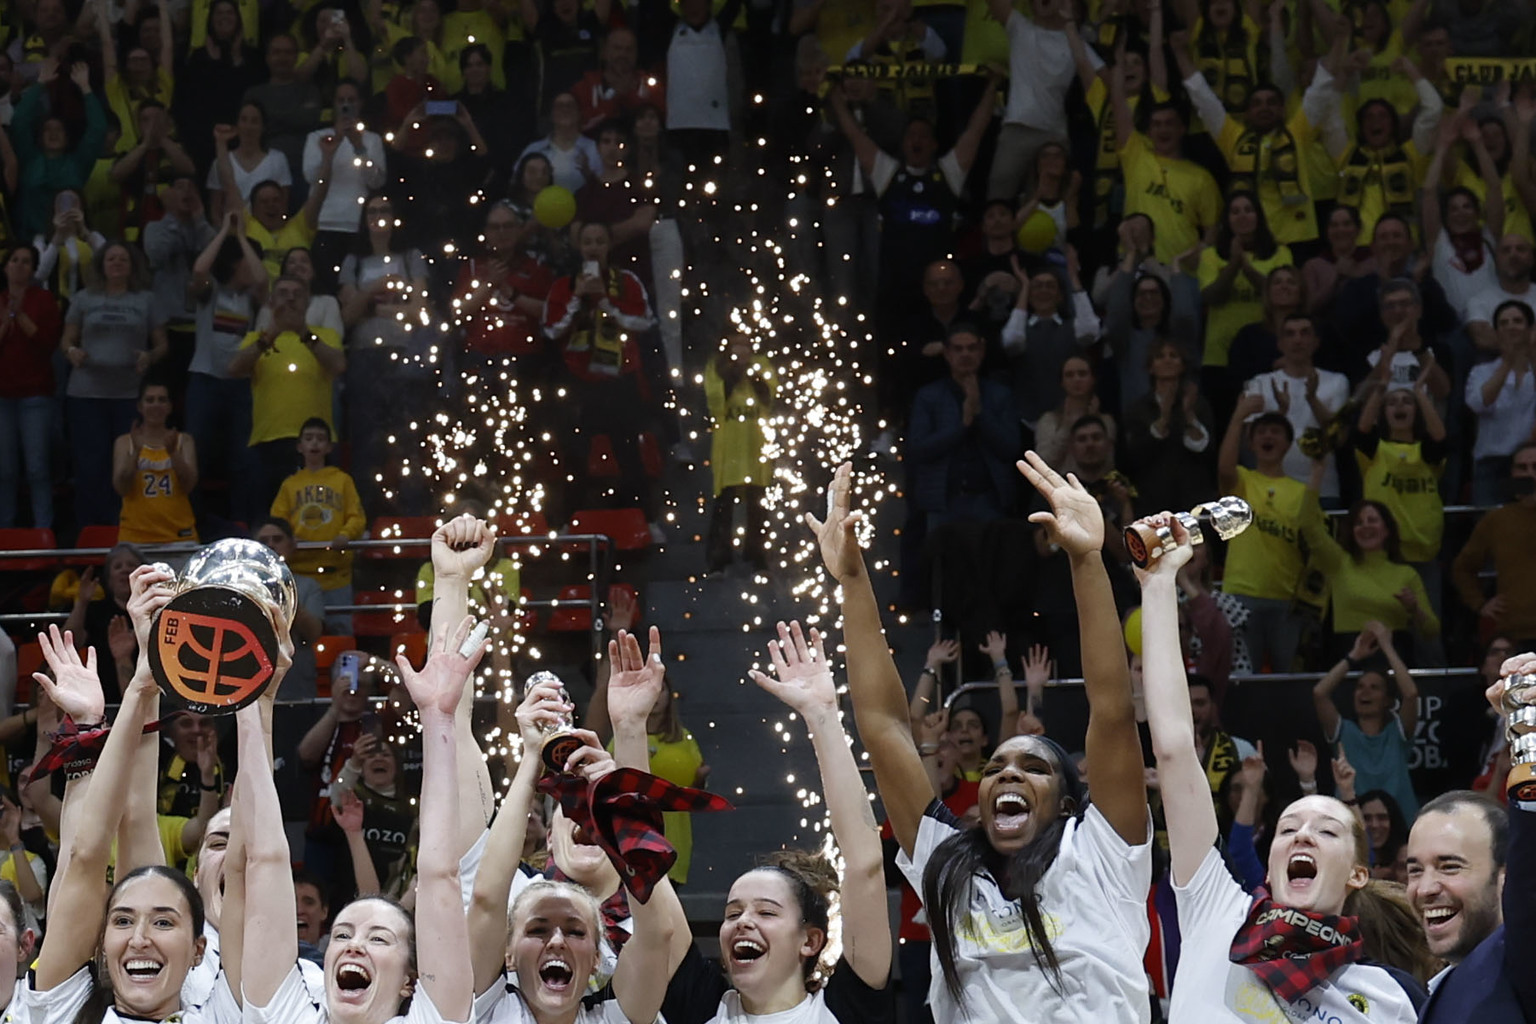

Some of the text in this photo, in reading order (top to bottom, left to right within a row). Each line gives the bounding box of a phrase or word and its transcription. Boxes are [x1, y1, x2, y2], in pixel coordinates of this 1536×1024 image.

[143, 474, 173, 498] 24
[165, 617, 179, 645] FEB
[1256, 908, 1352, 947] CAMPEON
